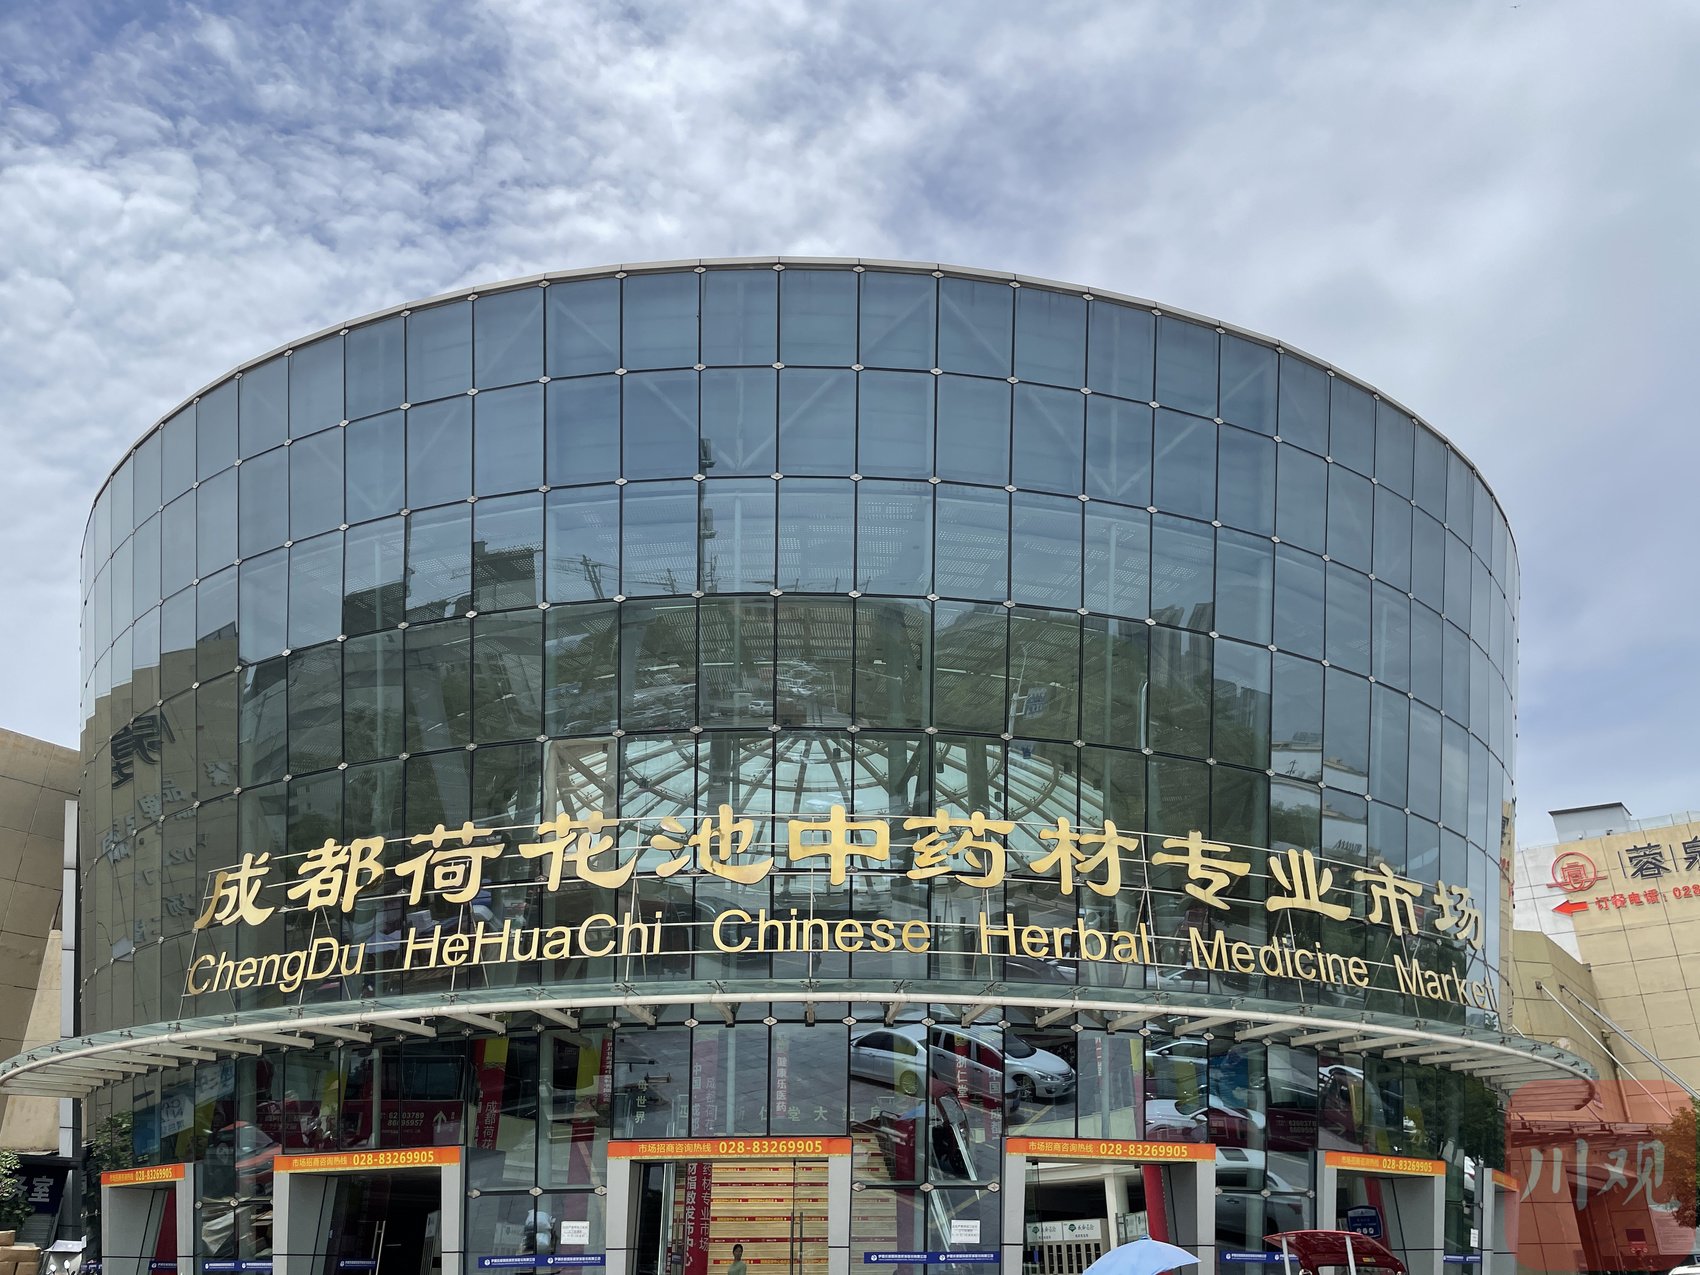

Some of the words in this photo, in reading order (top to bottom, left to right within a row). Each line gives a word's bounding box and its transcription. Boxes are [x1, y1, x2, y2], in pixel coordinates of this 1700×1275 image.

[194, 803, 1483, 950] 成都荷花池中药材专业市场
[188, 937, 366, 994] ChengDu
[403, 911, 662, 970] HeHuaChi
[712, 909, 931, 953] Chinese
[979, 912, 1150, 964] Herbal
[1189, 927, 1369, 988] Medicine
[1393, 955, 1498, 1012] Market
[719, 1141, 822, 1154] 028-83269905
[1100, 1143, 1188, 1157] 028-83269905
[352, 1151, 434, 1166] 028-83269905
[1382, 1158, 1433, 1173] 028-83269905
[135, 1167, 173, 1181] 028-83269905
